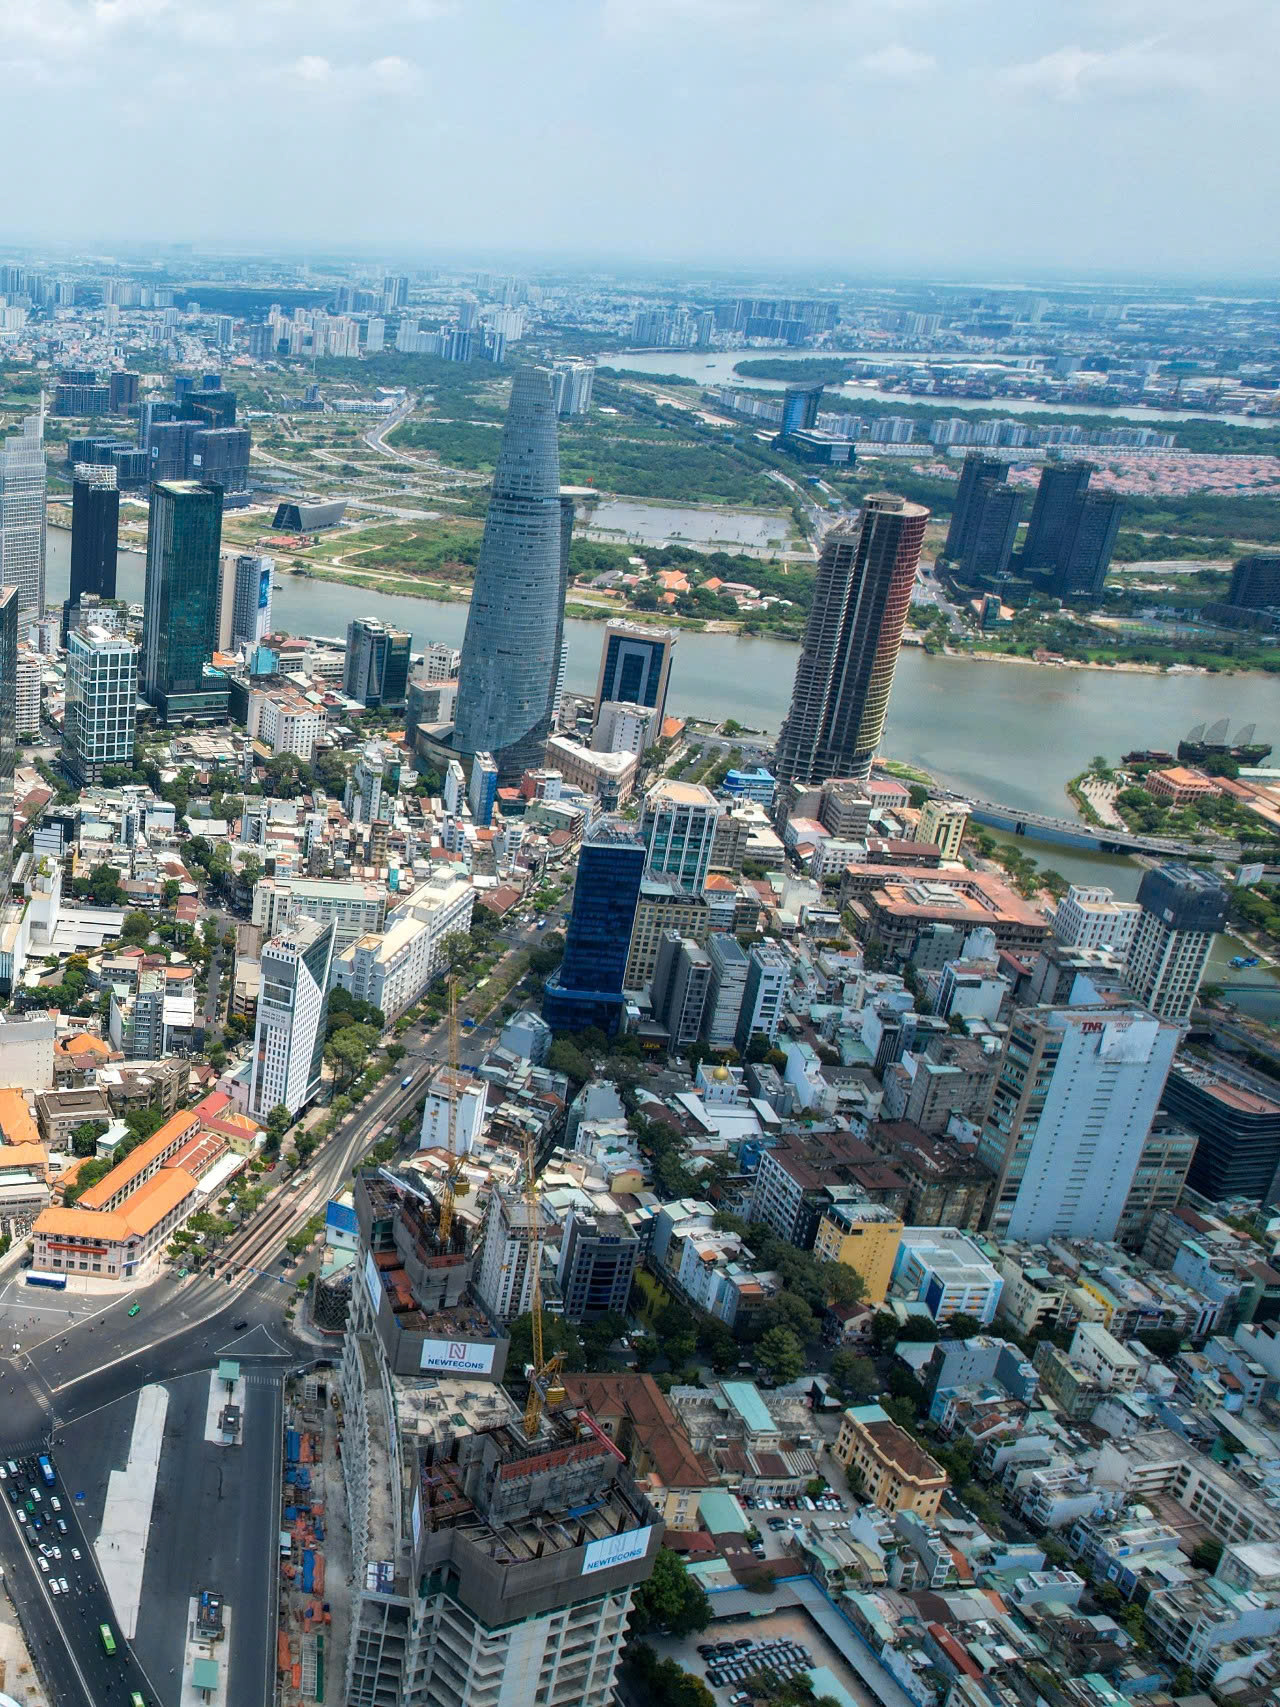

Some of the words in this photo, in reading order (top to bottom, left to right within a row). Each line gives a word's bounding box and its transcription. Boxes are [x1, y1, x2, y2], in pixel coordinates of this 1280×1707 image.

[281, 941, 296, 951] MB
[1081, 1022, 1103, 1031] TNR
[427, 1358, 484, 1370] NEWTECONS
[586, 1547, 643, 1570] NEWTECONS
